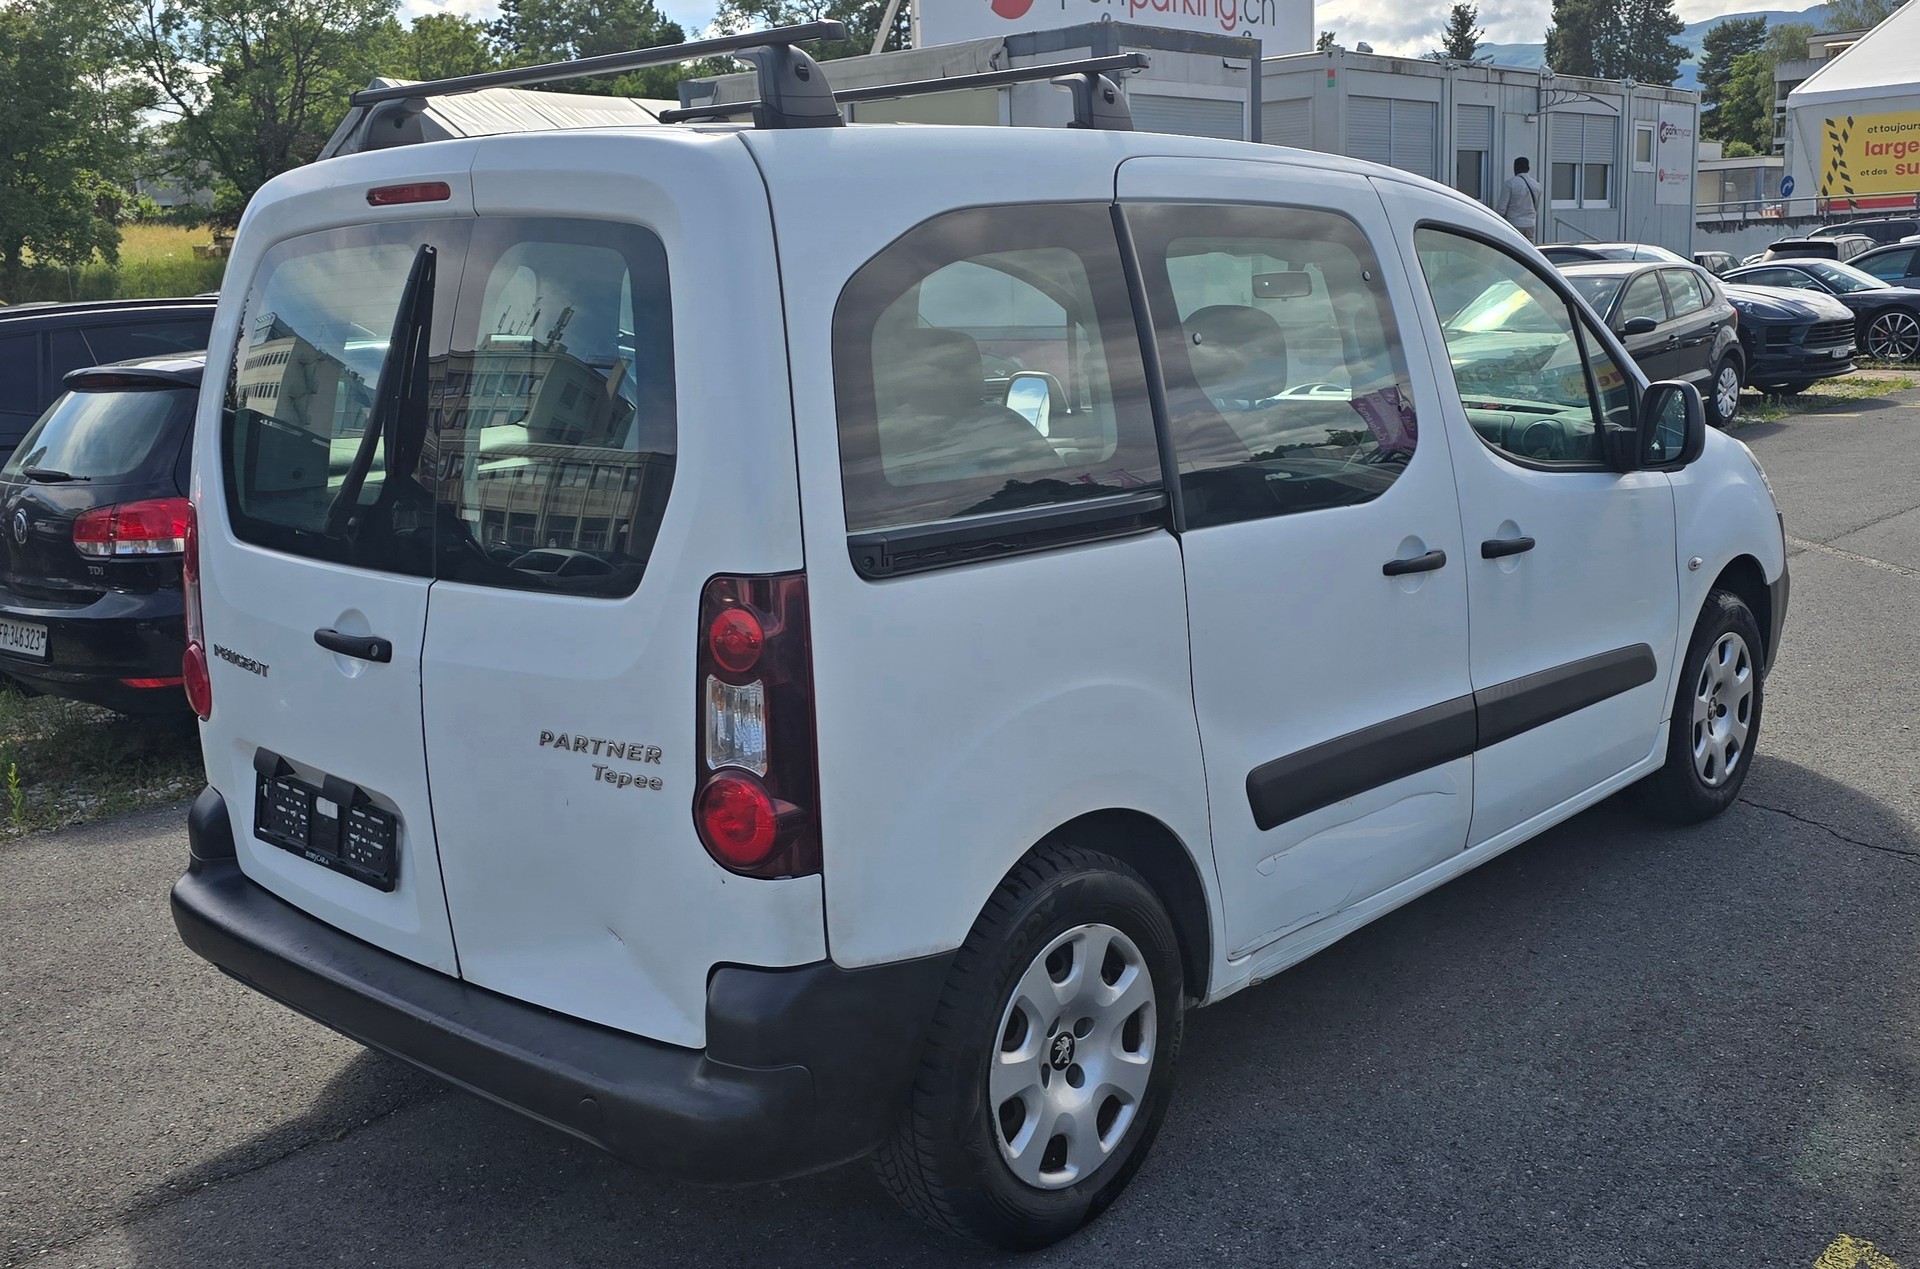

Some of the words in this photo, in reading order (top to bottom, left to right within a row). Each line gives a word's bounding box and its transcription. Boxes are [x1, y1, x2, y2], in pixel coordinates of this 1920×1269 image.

[1867, 125, 1878, 134] et
[1865, 140, 1920, 160] large
[1860, 169, 1870, 177] et
[1871, 168, 1888, 176] des
[87, 565, 104, 576] TDI
[213, 642, 270, 678] PEUGEOT
[539, 729, 663, 765] PARTNER
[592, 762, 664, 791] Tepee
